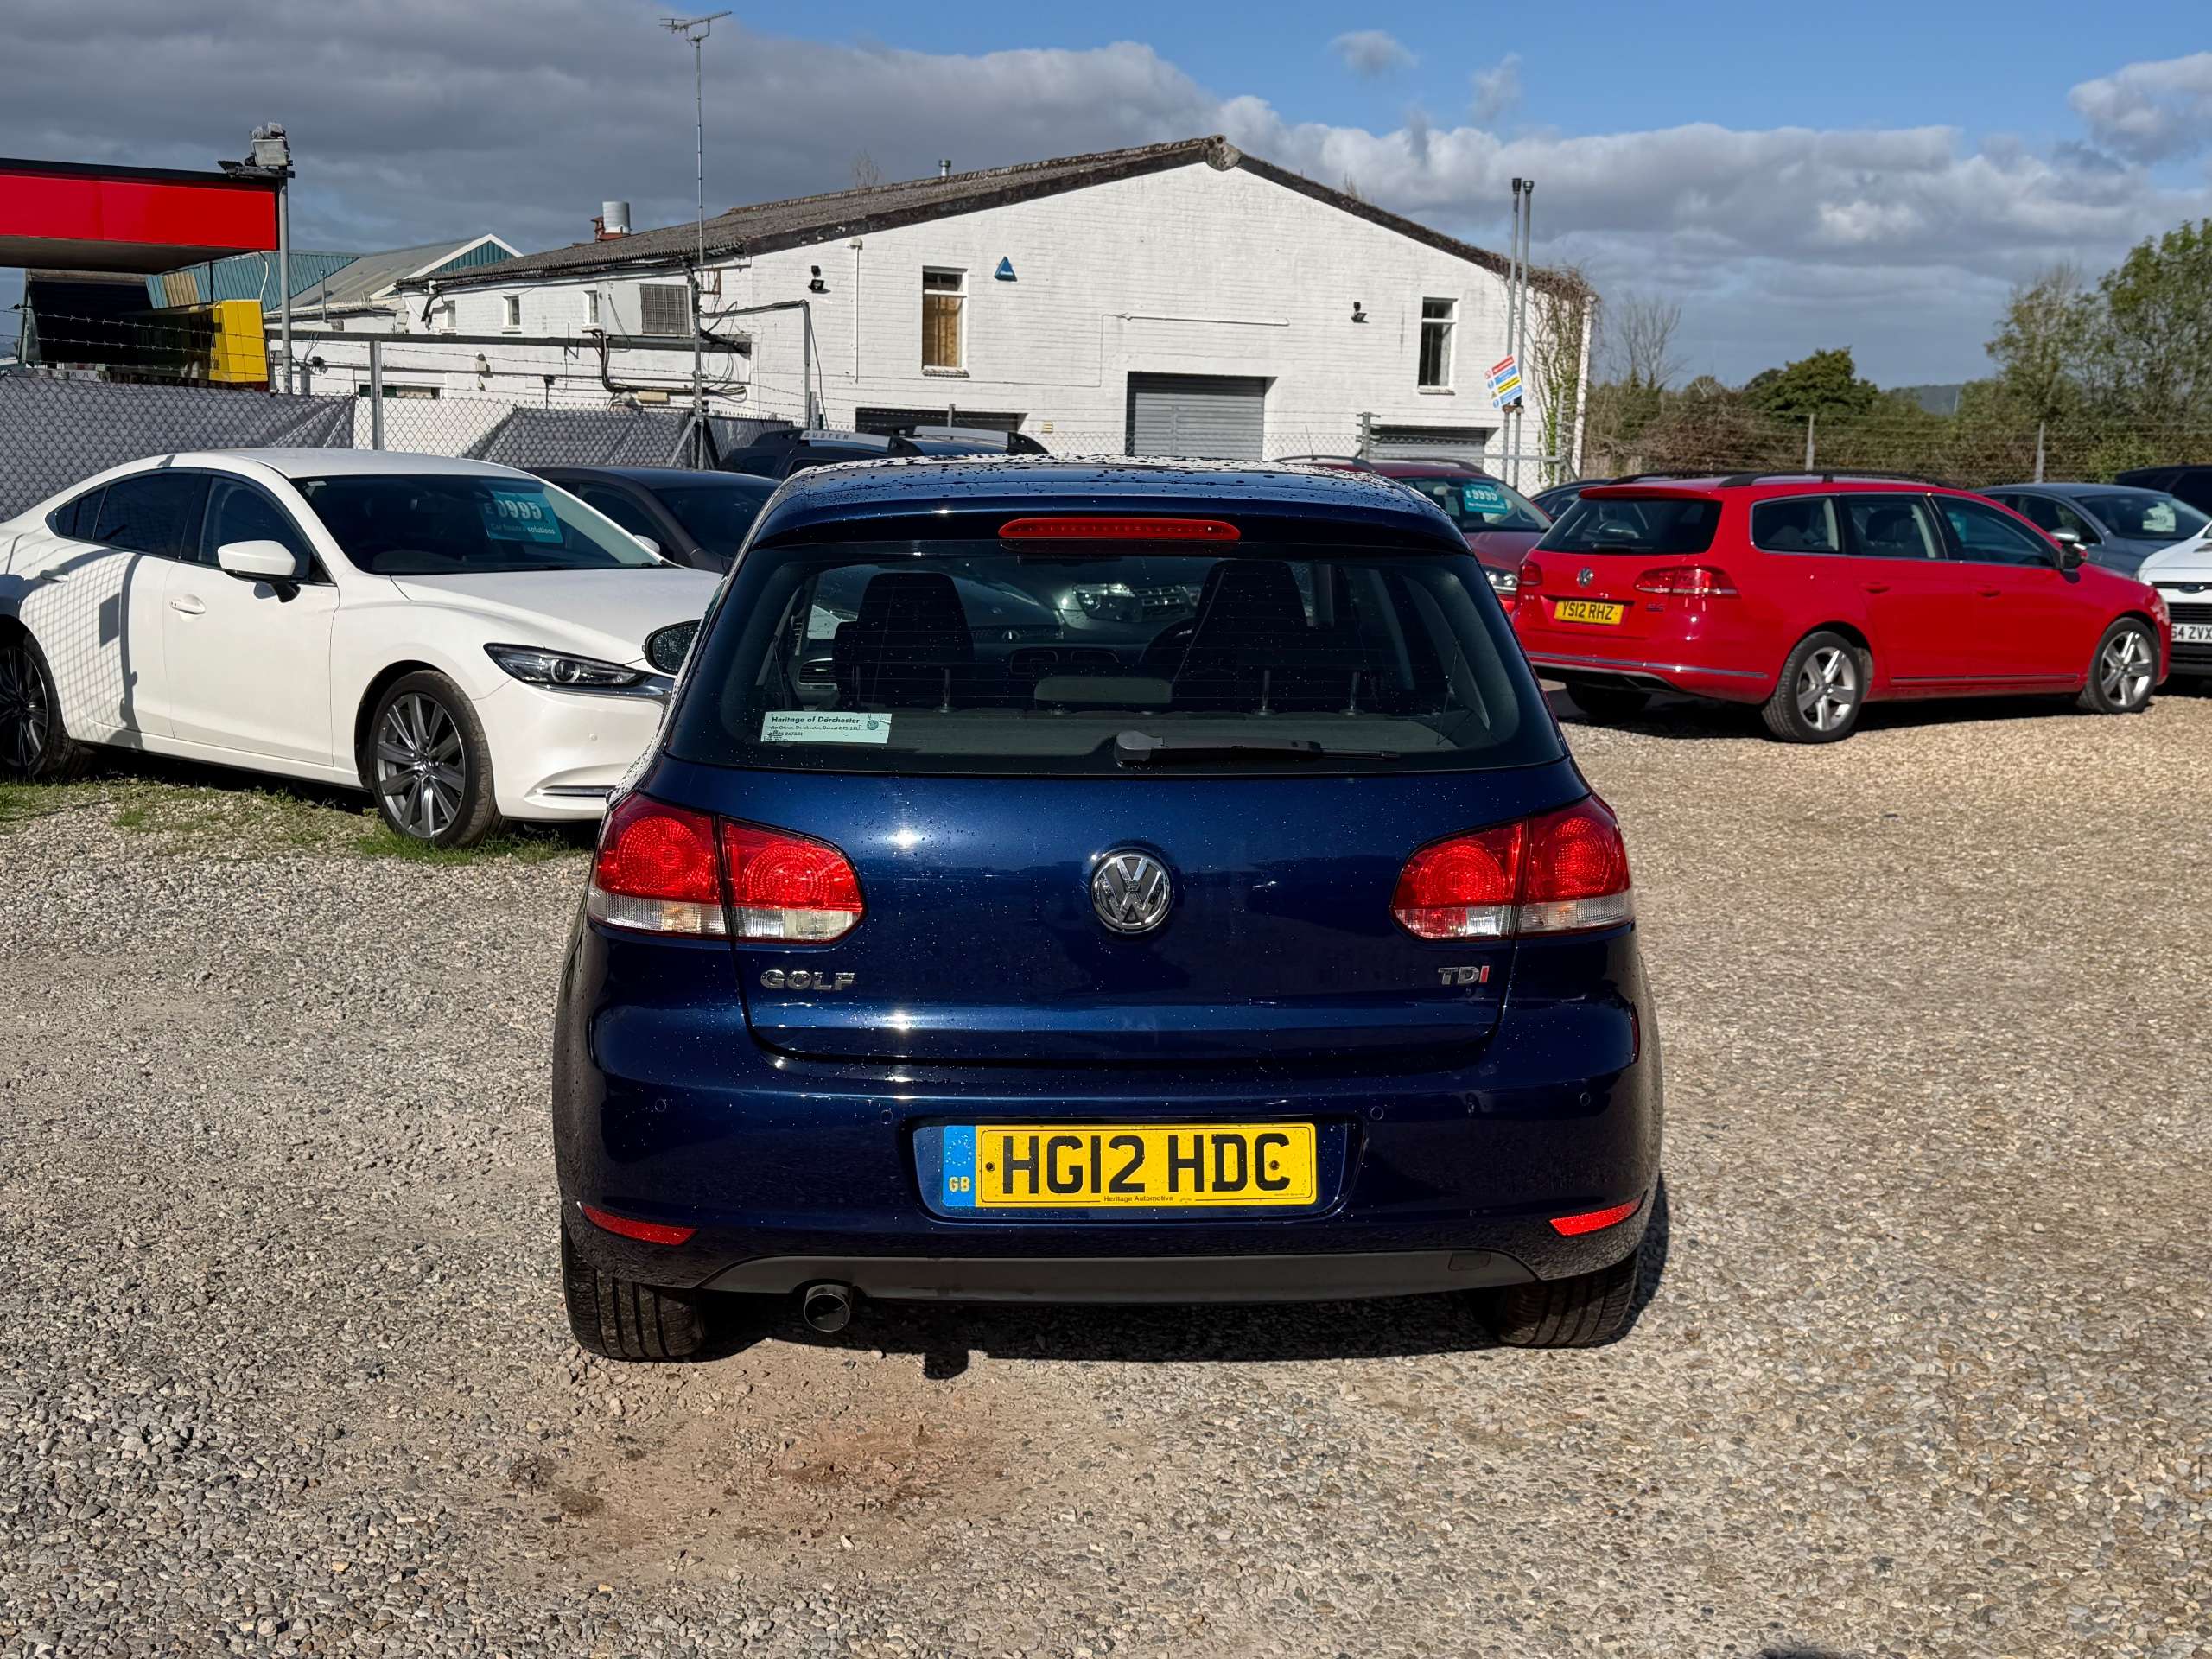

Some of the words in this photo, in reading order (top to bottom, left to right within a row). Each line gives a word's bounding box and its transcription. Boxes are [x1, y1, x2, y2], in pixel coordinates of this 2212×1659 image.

[1562, 601, 1586, 618] YS12
[1588, 603, 1615, 620] RHZ
[2188, 626, 2212, 639] ZVX
[760, 969, 855, 991] GOLF
[1438, 965, 1490, 985] TDI
[1003, 1135, 1146, 1195] HG12
[1168, 1133, 1291, 1193] HDC
[949, 1176, 971, 1193] GB
[1103, 1195, 1133, 1204] Heritage
